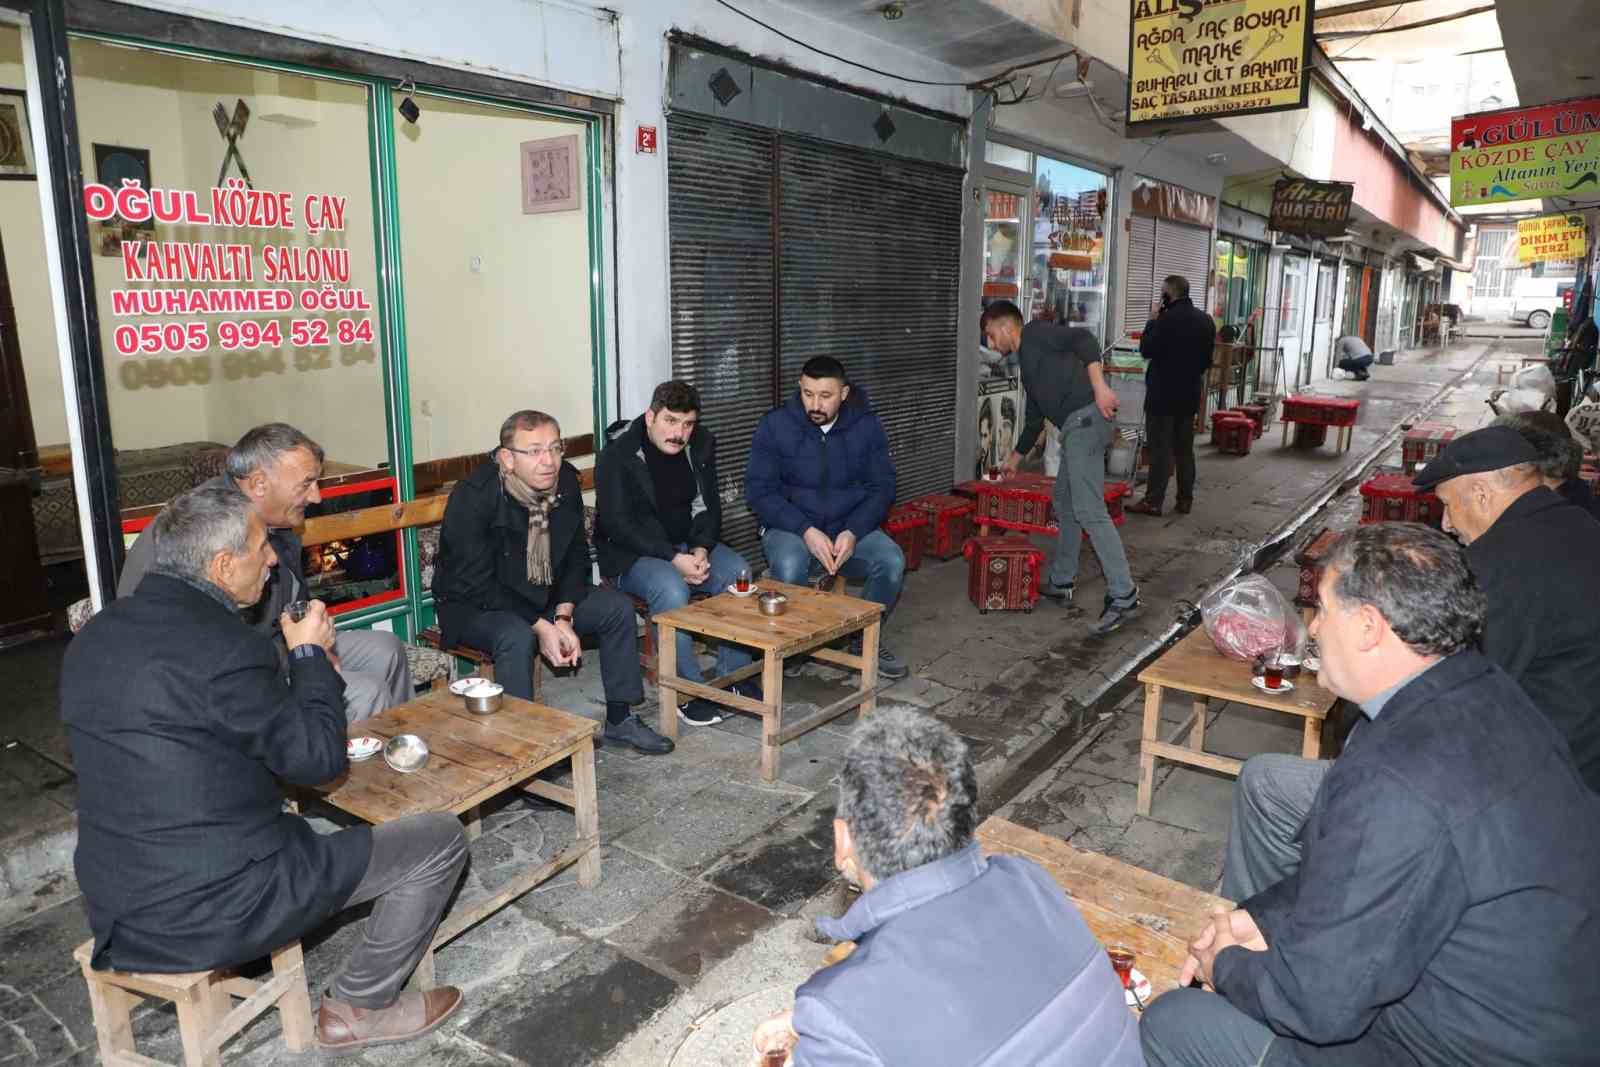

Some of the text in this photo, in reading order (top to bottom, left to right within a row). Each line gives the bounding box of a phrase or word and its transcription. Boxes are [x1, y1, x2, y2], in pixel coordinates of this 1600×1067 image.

[1137, 5, 1301, 49] AĞDA SAÇ BOYASI
[1182, 40, 1243, 66] MASKE
[1136, 56, 1299, 93] BUHARLI CİLT BAKIMI
[1131, 95, 1158, 111] SAÇ
[1161, 86, 1226, 106] TASARIM
[1461, 138, 1590, 170] KÖZDE ÇAY
[1564, 156, 1600, 174] Yeri
[83, 178, 347, 235] OĞUL KÖZDE ÇAY
[121, 241, 350, 283] KAHVALTI SALONU
[110, 286, 371, 316] MUHAMMED OĞUL
[114, 319, 373, 356] 0505 994 52 84
